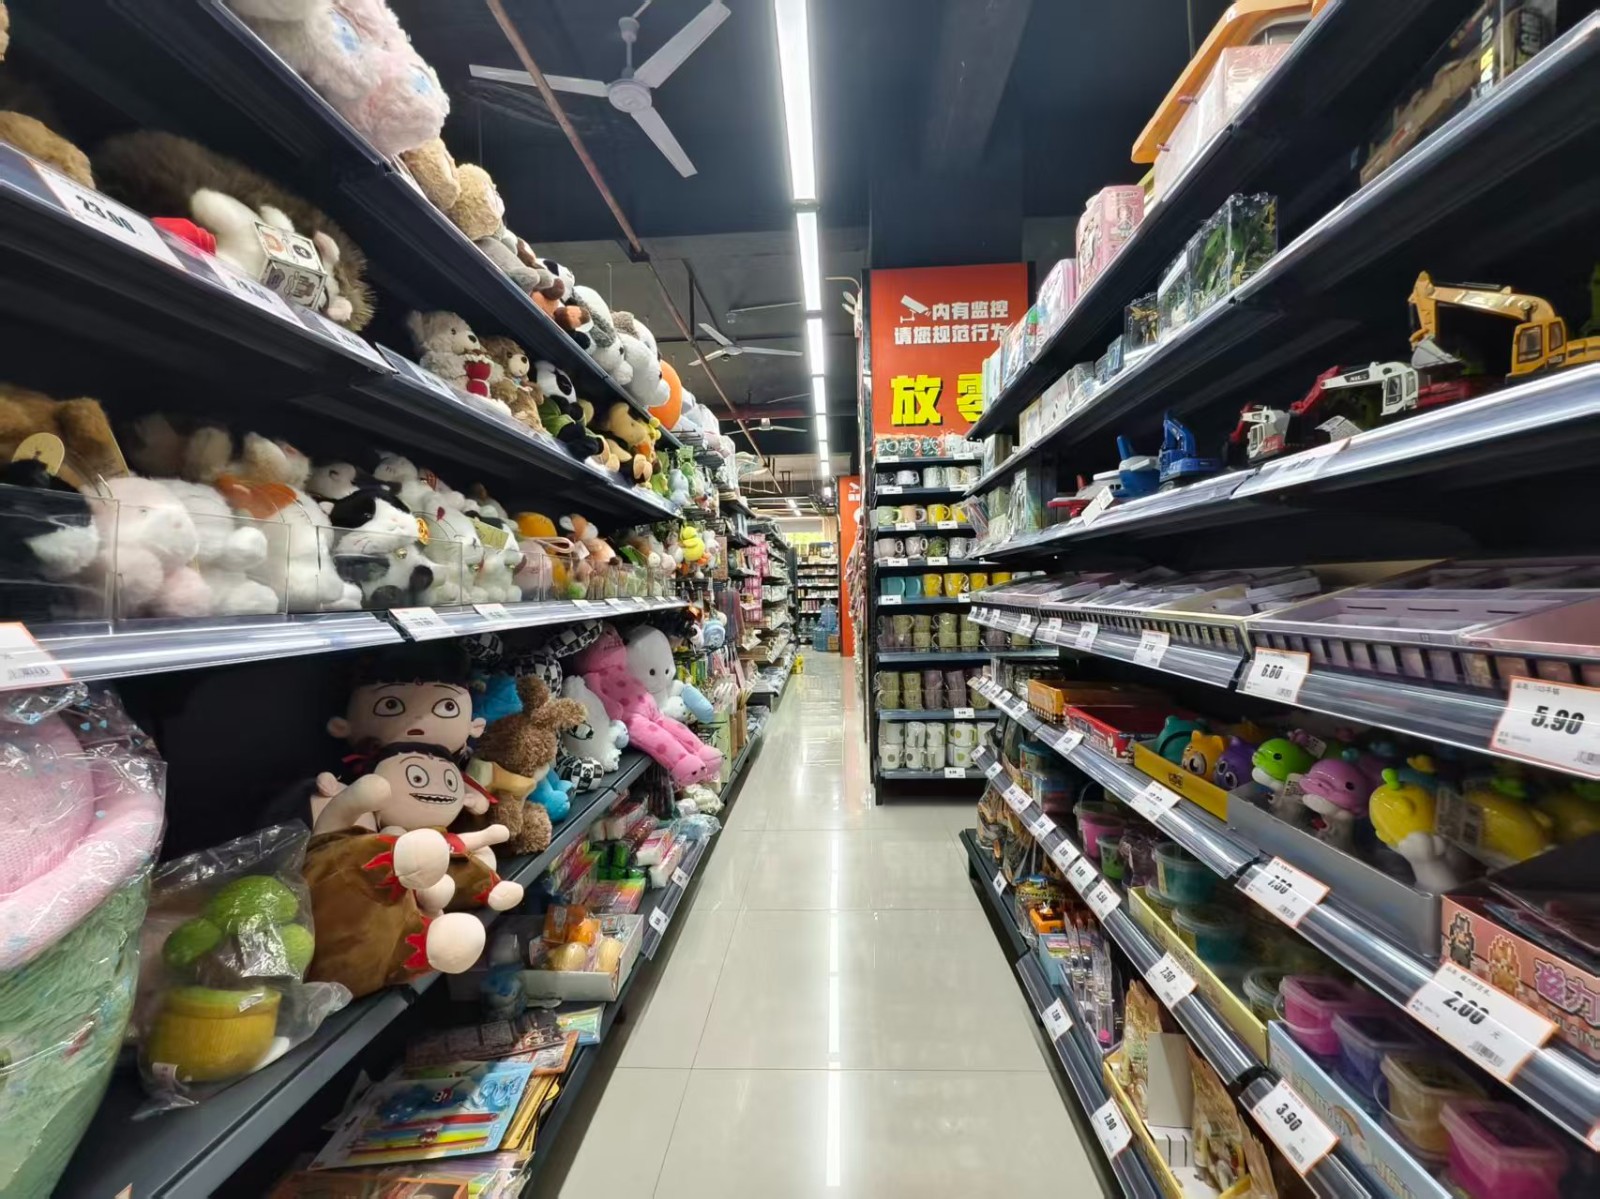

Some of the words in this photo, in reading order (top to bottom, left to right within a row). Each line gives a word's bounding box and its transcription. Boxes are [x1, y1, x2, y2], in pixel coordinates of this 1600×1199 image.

[932, 300, 1009, 321] 内有监控
[1530, 705, 1585, 735] 5.90
[1443, 991, 1489, 1025] 2.00
[1276, 1103, 1303, 1131] 3.90
